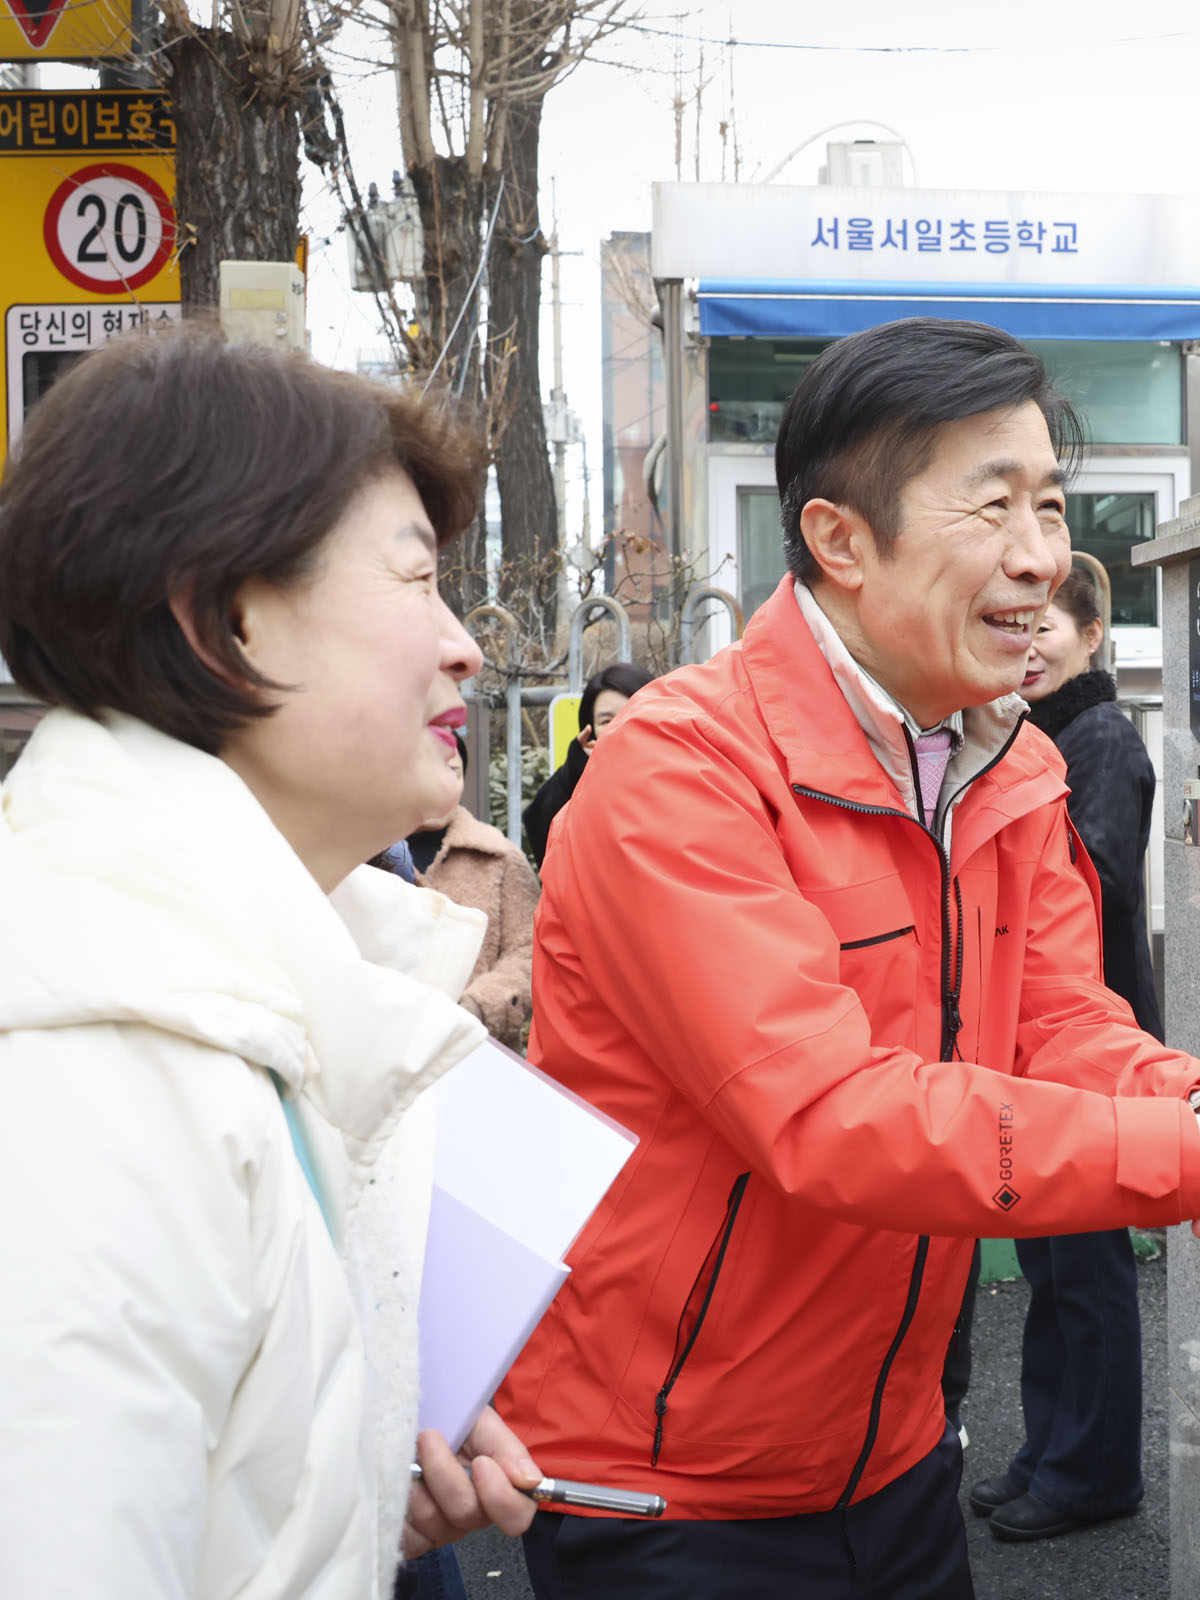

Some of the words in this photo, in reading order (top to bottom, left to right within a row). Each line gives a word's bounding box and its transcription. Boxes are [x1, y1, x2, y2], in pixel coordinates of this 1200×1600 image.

[77, 193, 146, 263] 20
[811, 217, 1078, 254] 서울서일초등학교
[20, 310, 91, 345] 당신의
[995, 924, 1009, 937] AK
[999, 1101, 1013, 1181] GORE-TEX
